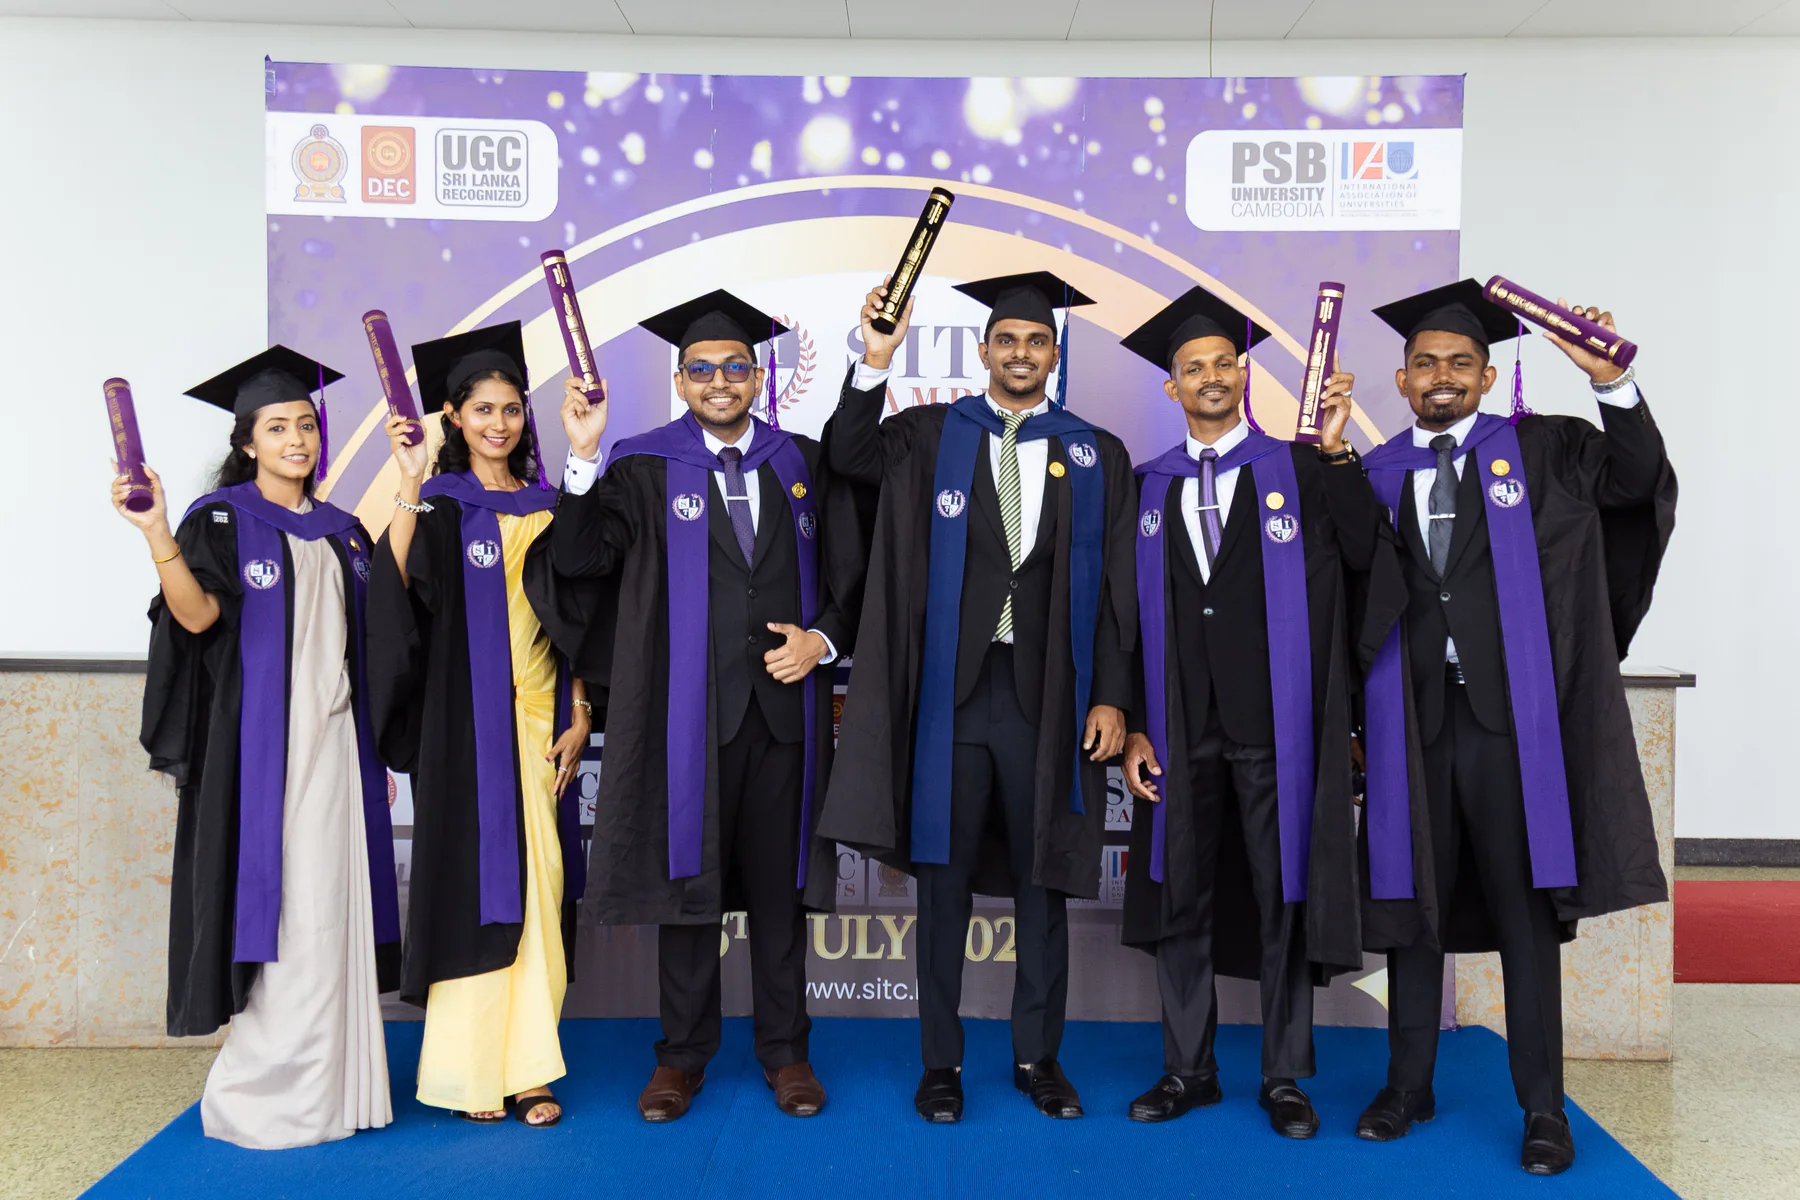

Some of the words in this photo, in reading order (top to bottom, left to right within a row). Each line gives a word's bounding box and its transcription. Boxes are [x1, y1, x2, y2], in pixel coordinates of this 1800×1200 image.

[442, 135, 521, 172] UGC
[1231, 141, 1327, 184] PSB
[368, 177, 411, 197] DEC
[442, 172, 467, 187] SRI
[472, 173, 520, 188] LANKA
[442, 188, 521, 202] RECOGNIZED
[1231, 186, 1325, 201] UNIVERSITY
[1231, 202, 1325, 218] CAMBODIA
[1339, 200, 1405, 208] UNIVERSITIES
[806, 914, 917, 960] ULY
[806, 977, 919, 1000] ww.sitc.
